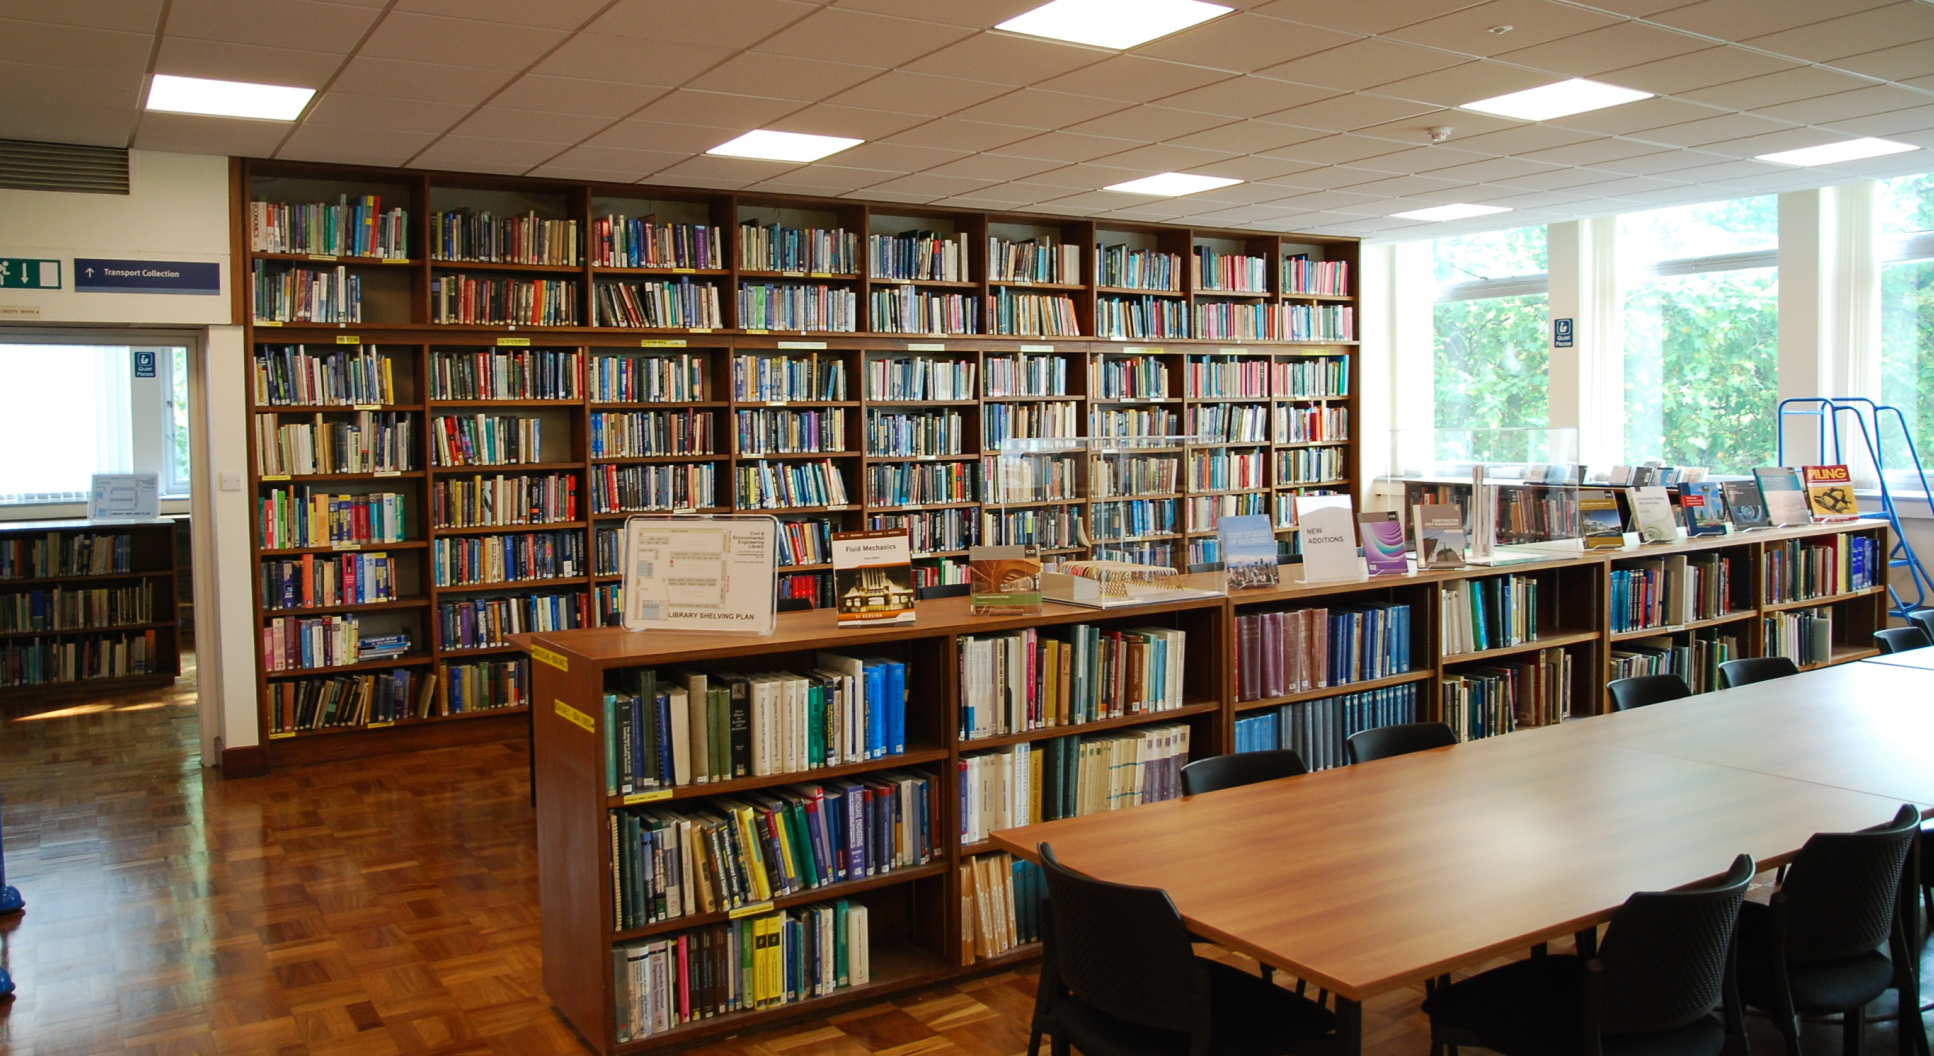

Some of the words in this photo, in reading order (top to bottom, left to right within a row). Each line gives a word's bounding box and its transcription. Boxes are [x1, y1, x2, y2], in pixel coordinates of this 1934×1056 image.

[104, 268, 140, 277] Transport
[142, 269, 180, 278] Collection
[1308, 535, 1344, 544] ADDITIONS
[668, 611, 698, 619] LIBRARY
[700, 612, 735, 620] SHELVING
